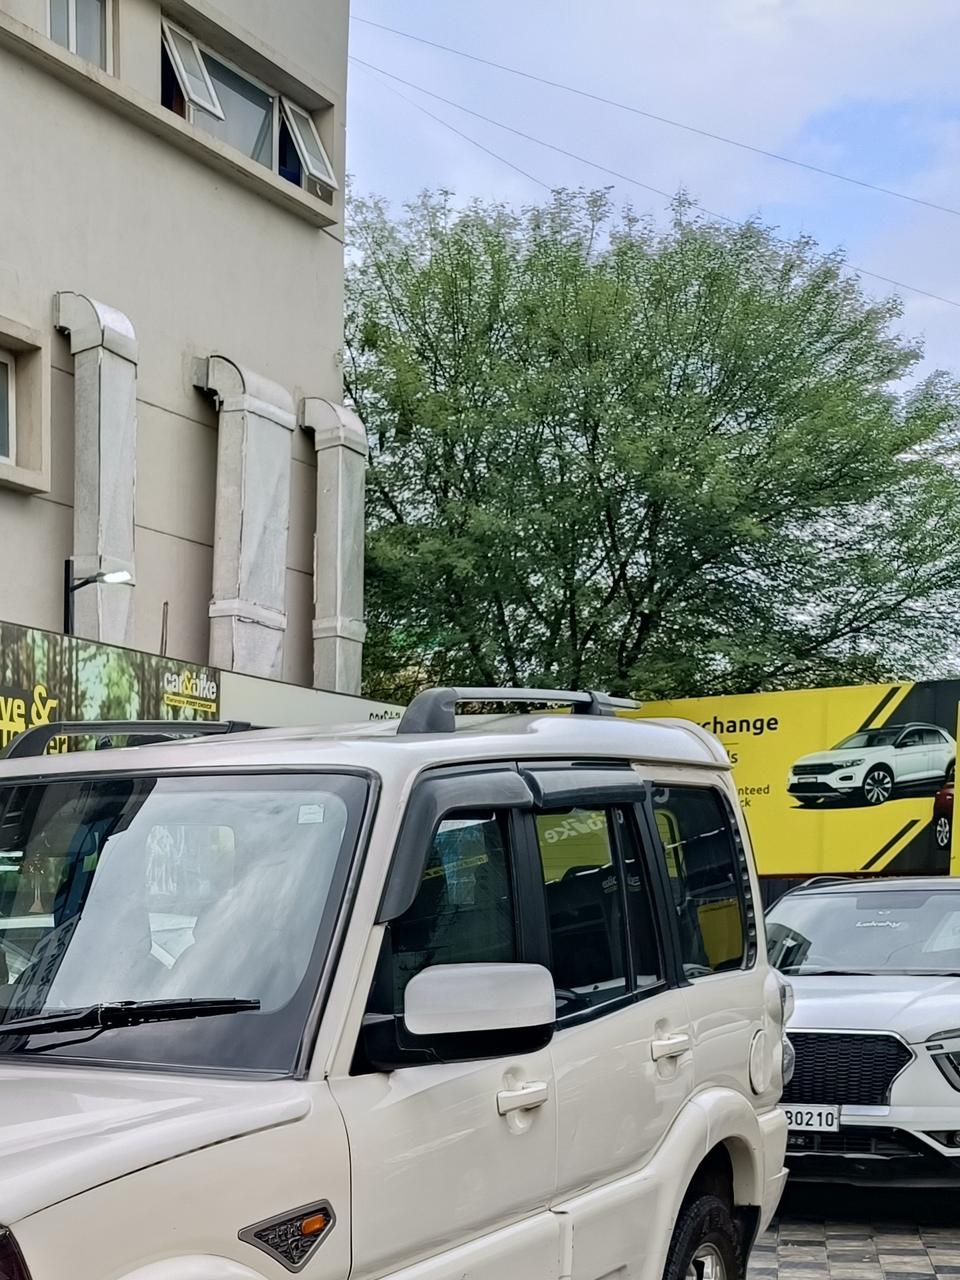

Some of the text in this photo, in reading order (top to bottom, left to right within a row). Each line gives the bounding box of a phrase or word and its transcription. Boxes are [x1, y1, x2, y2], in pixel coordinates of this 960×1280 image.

[163, 670, 217, 700] car&bike
[31, 684, 59, 725] &
[738, 784, 770, 796] nteed
